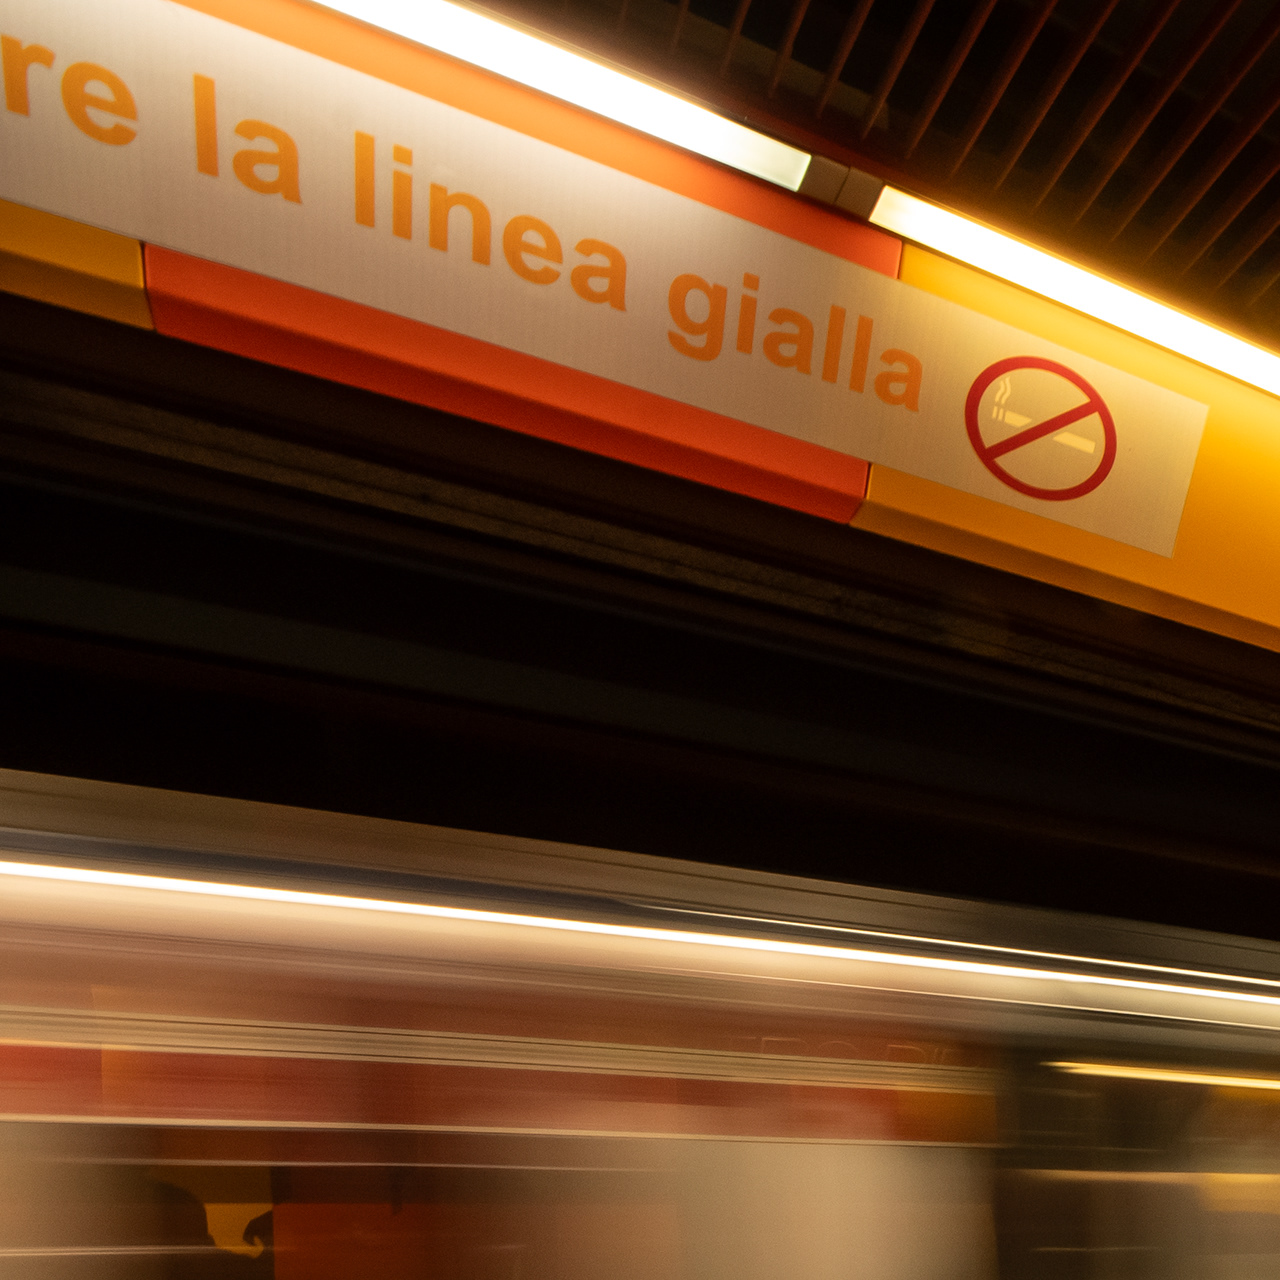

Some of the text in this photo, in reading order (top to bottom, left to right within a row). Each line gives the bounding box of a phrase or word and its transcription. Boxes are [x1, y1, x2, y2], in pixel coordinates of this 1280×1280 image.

[193, 72, 303, 205] la
[354, 129, 627, 312] linea
[667, 272, 923, 413] gialla
